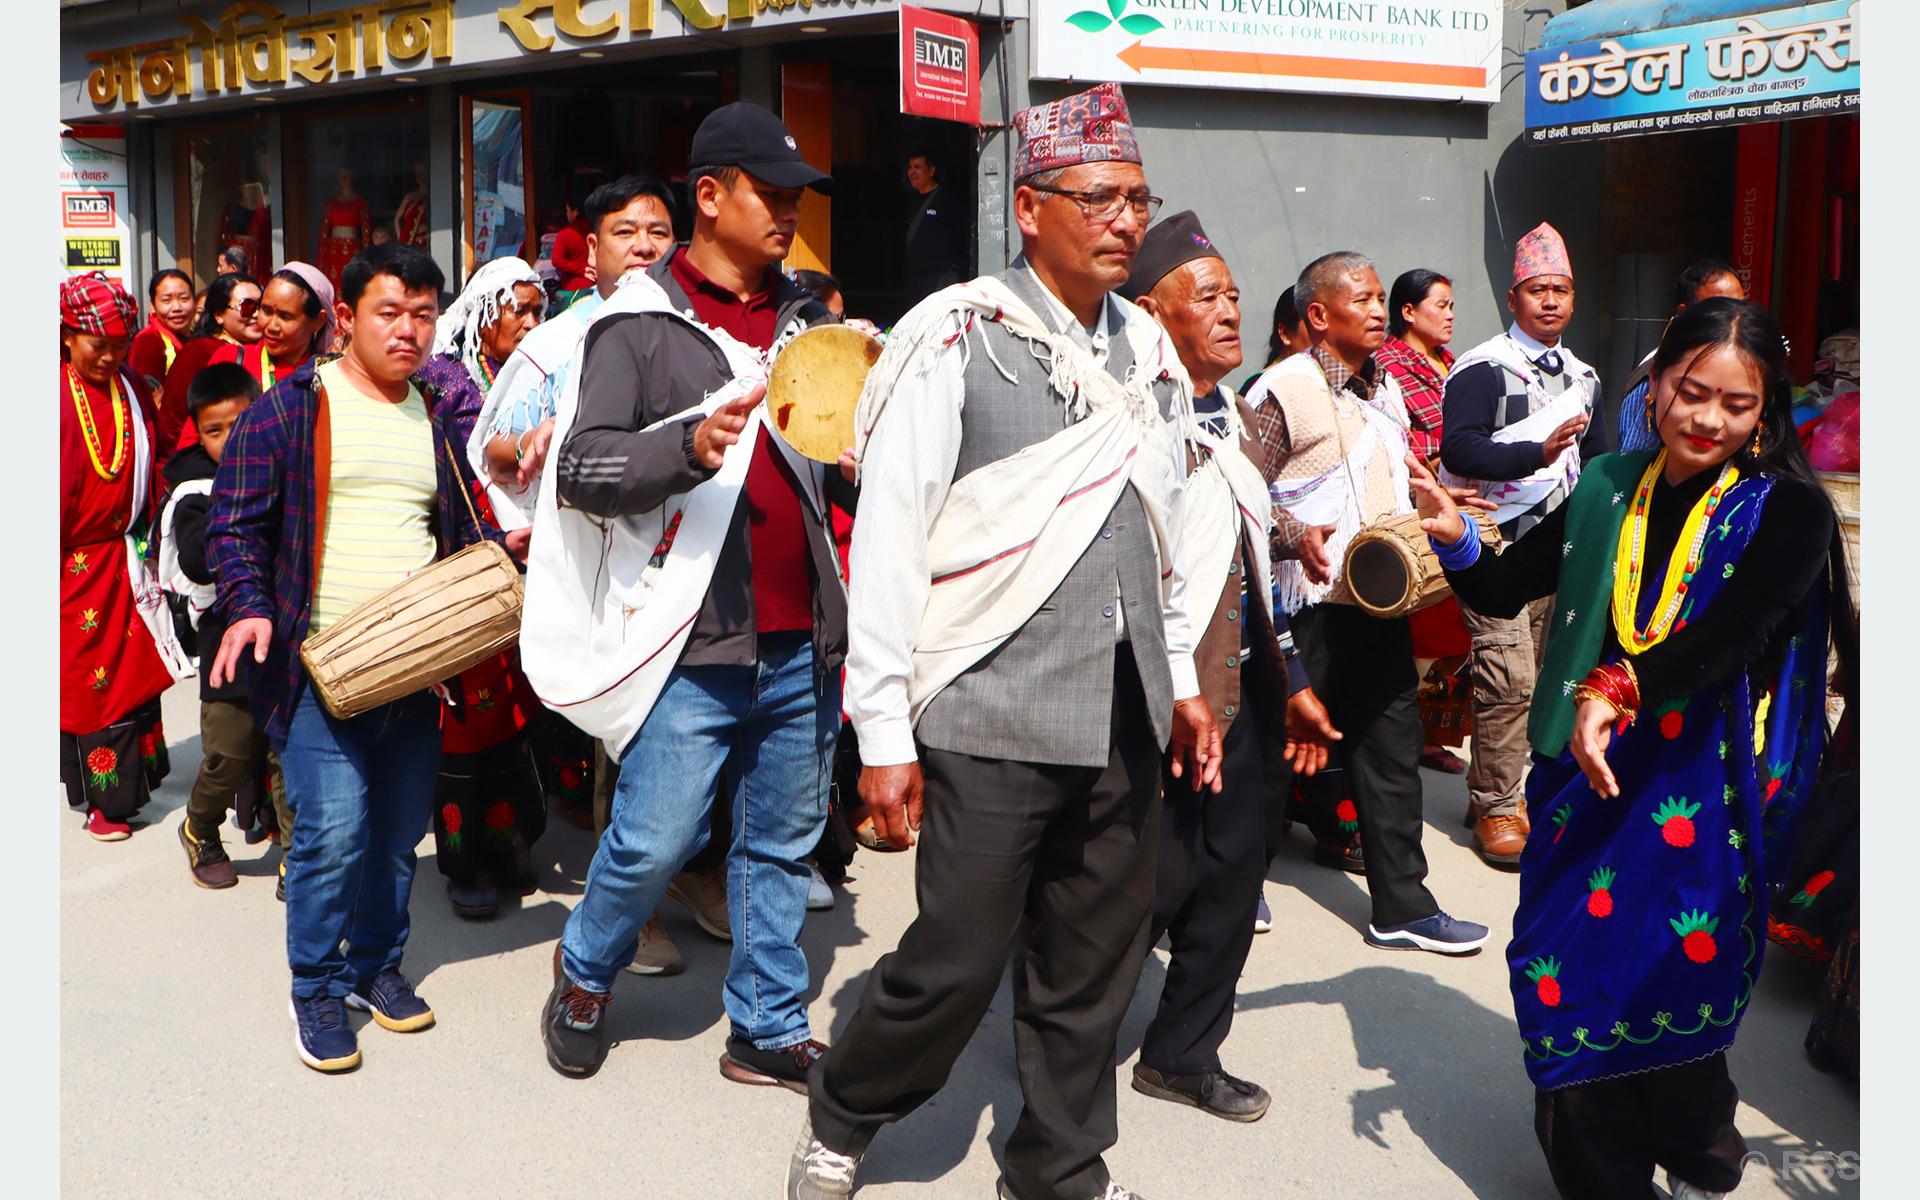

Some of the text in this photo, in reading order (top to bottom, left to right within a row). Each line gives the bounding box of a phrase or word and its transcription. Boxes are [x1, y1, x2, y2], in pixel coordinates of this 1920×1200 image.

[1173, 17, 1428, 47] PARTNERING FOR PROSPERITY
[1221, 0, 1378, 22] DEVELOPMENT
[1387, 5, 1442, 28] BANK
[1452, 11, 1489, 32] LTD
[85, 0, 456, 104] मनोविज्ञान
[924, 40, 963, 72] IME
[1539, 40, 1689, 102] कंडेल
[73, 199, 108, 213] IME
